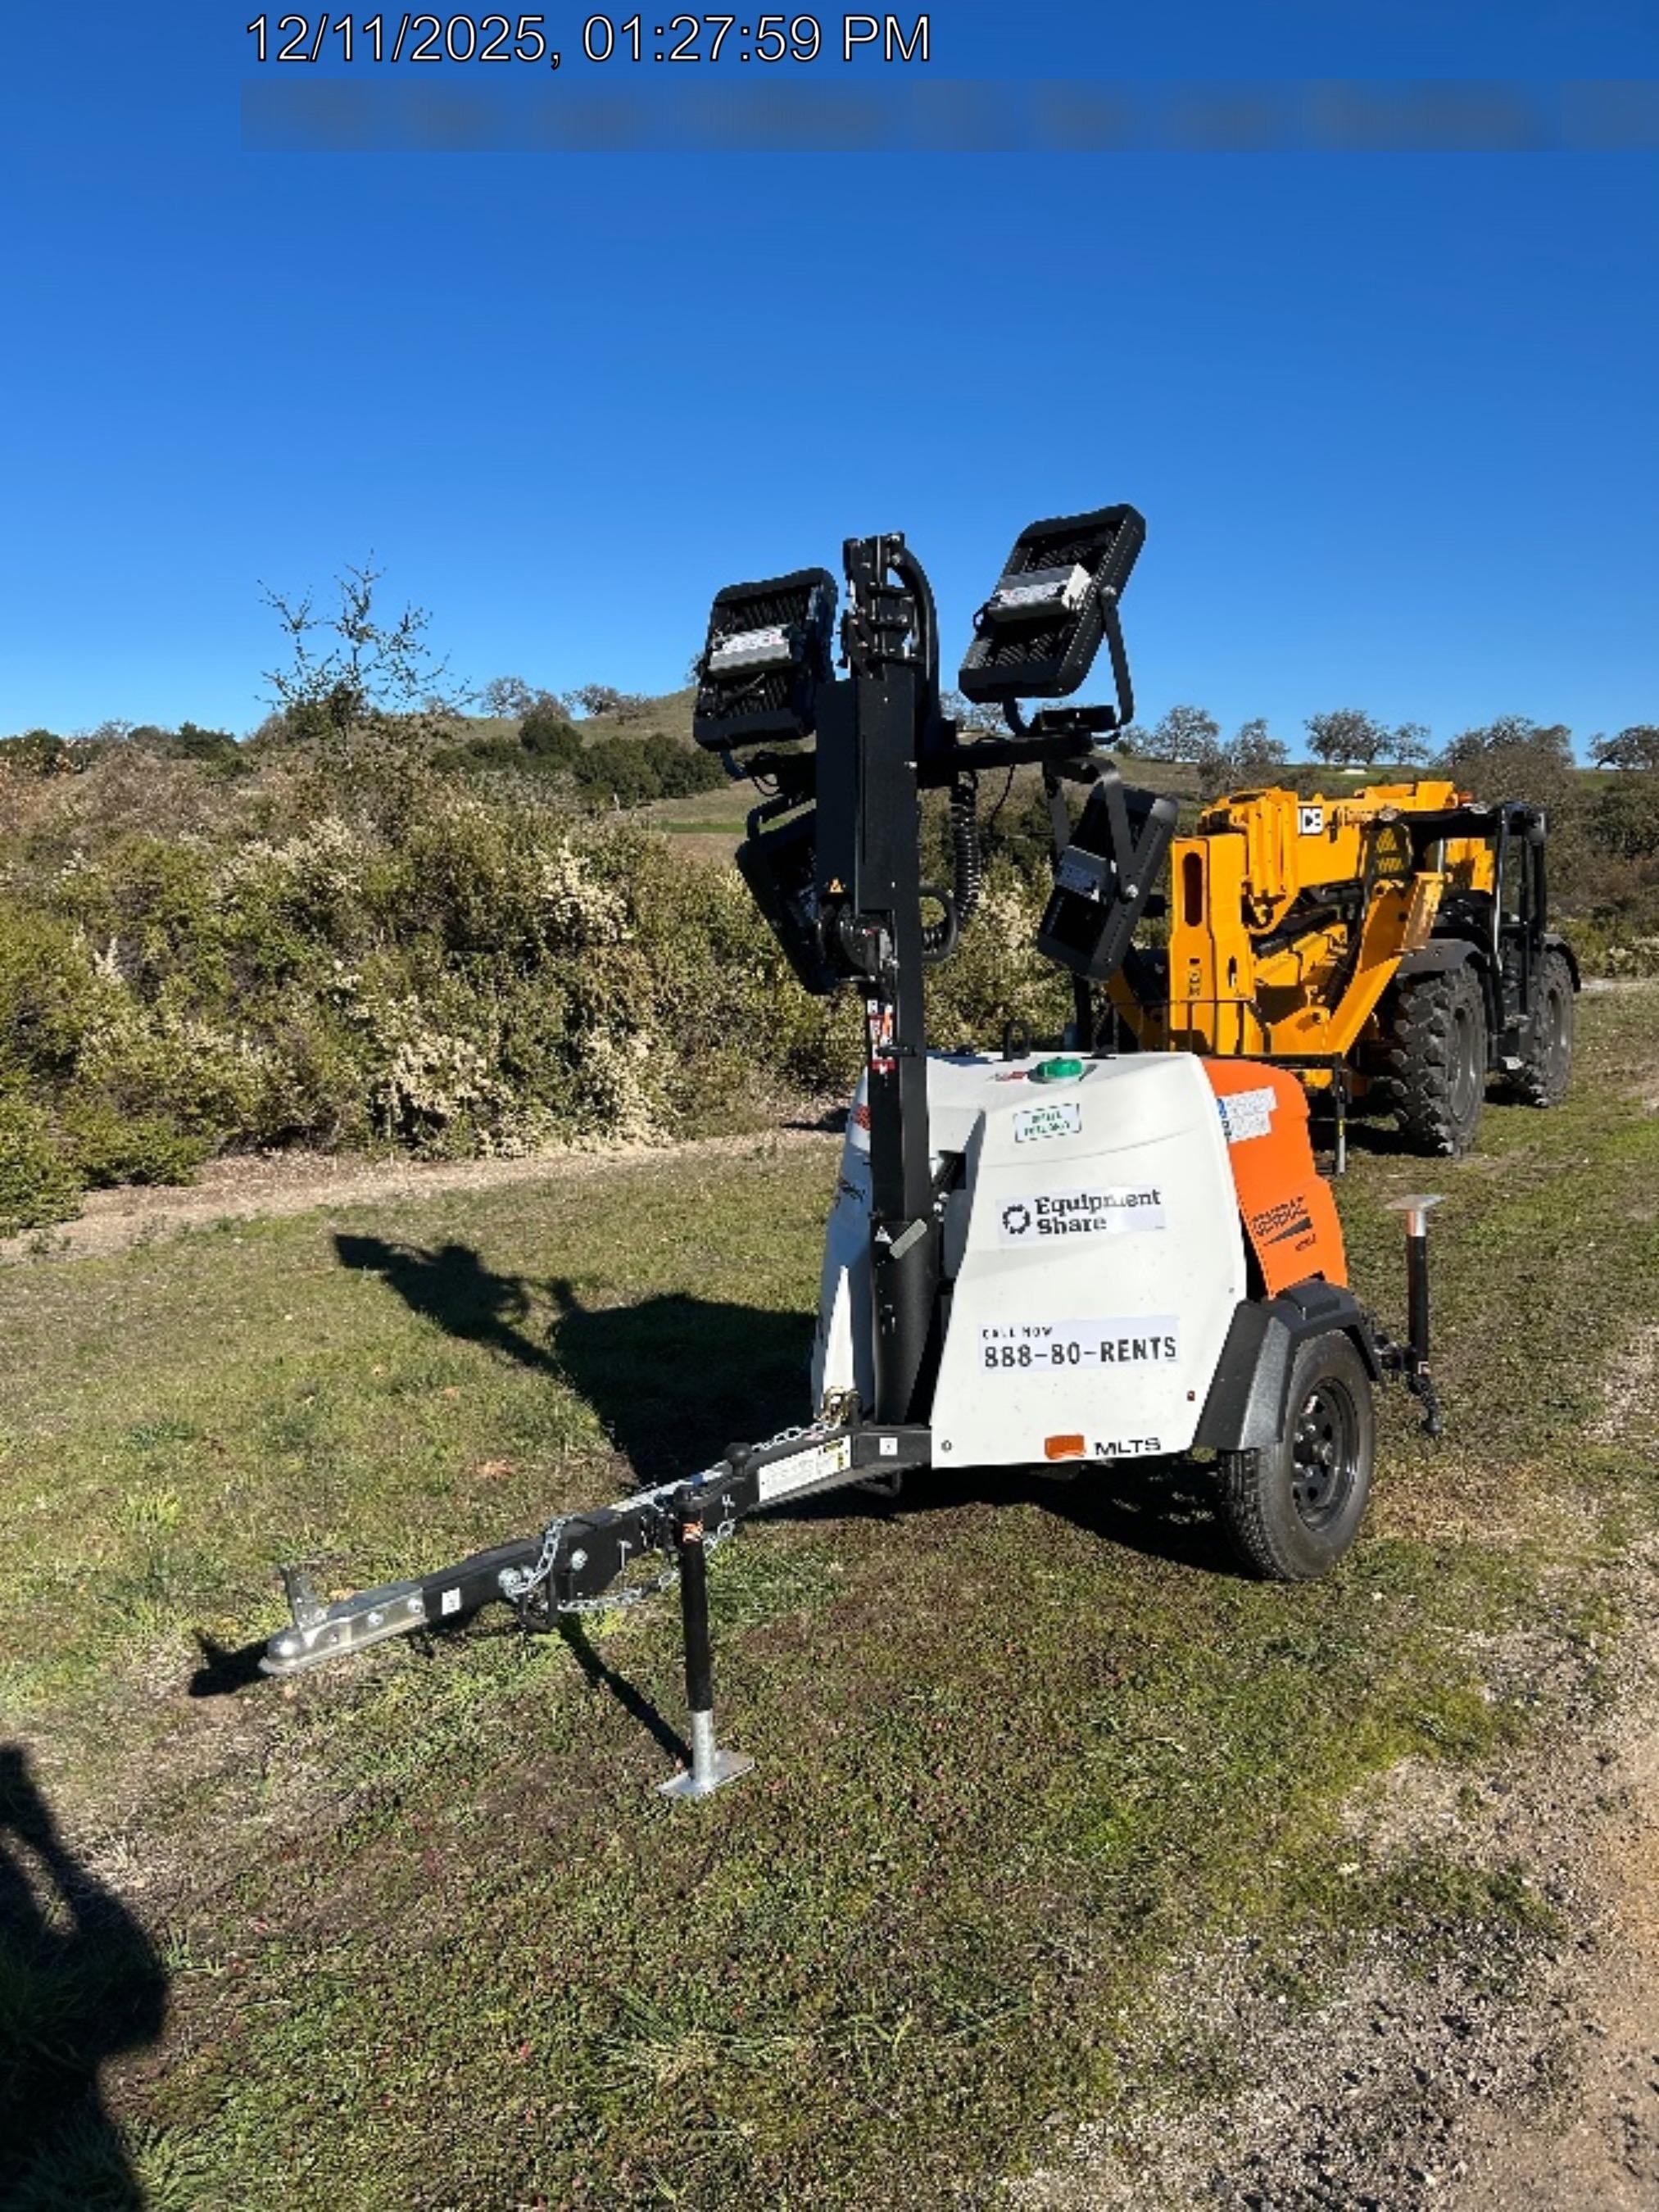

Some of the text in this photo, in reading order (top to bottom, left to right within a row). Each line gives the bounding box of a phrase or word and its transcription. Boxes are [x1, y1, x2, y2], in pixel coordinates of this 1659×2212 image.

[1036, 1216, 1107, 1235] Share
[985, 1336, 1176, 1367] 888-80-RENTS
[1095, 1437, 1161, 1455] MLTS
